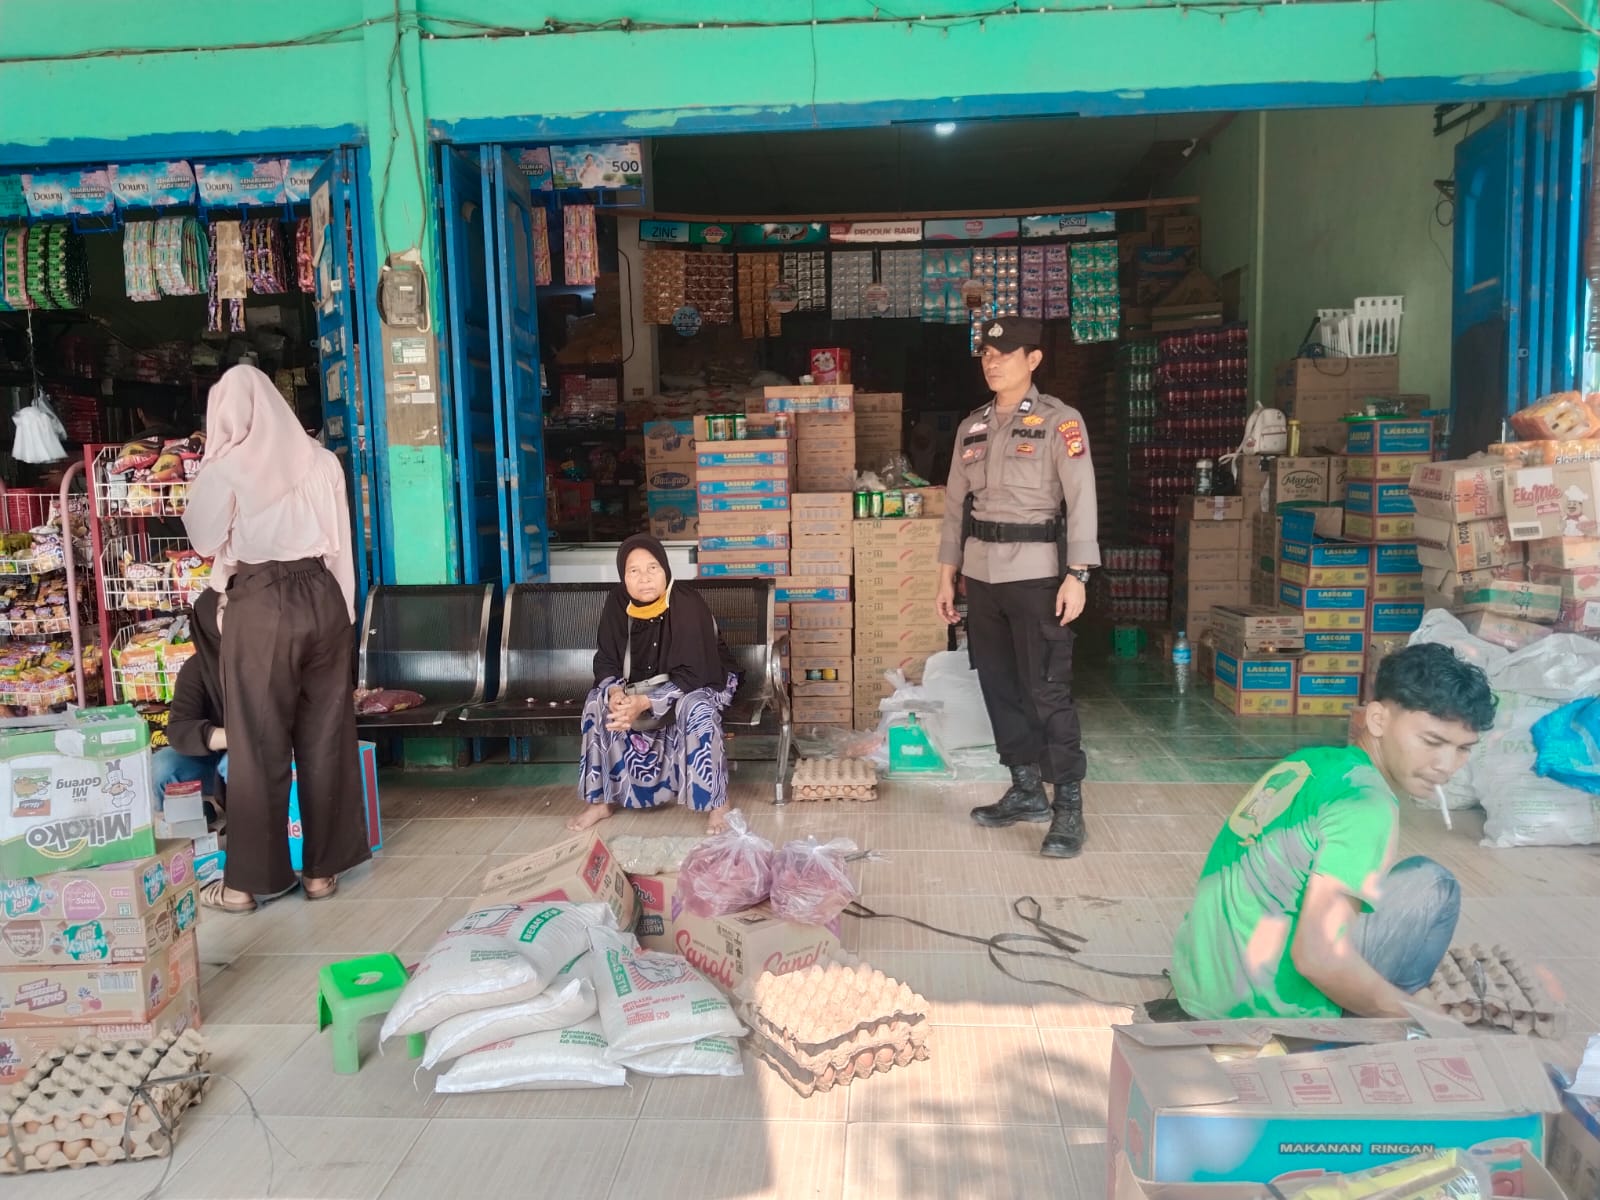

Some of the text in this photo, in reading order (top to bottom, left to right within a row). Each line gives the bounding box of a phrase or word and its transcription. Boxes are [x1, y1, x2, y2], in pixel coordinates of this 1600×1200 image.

[612, 161, 638, 172] 500
[118, 182, 149, 193] Downy
[205, 183, 232, 192] Downy
[34, 192, 62, 202] Downy
[652, 226, 678, 238] ZINC
[854, 228, 891, 236] PRODUK
[1012, 428, 1046, 439] POLRI
[1282, 470, 1322, 488] Marjan
[1513, 484, 1562, 503] EkoMie
[835, 590, 846, 599] 24
[56, 776, 101, 790] Goreng
[72, 786, 88, 798] Mi
[28, 812, 132, 850] Mikako
[523, 918, 545, 940] BERAS
[615, 974, 630, 996] STM
[1280, 1143, 1435, 1154] MAKANAN RINGAN
